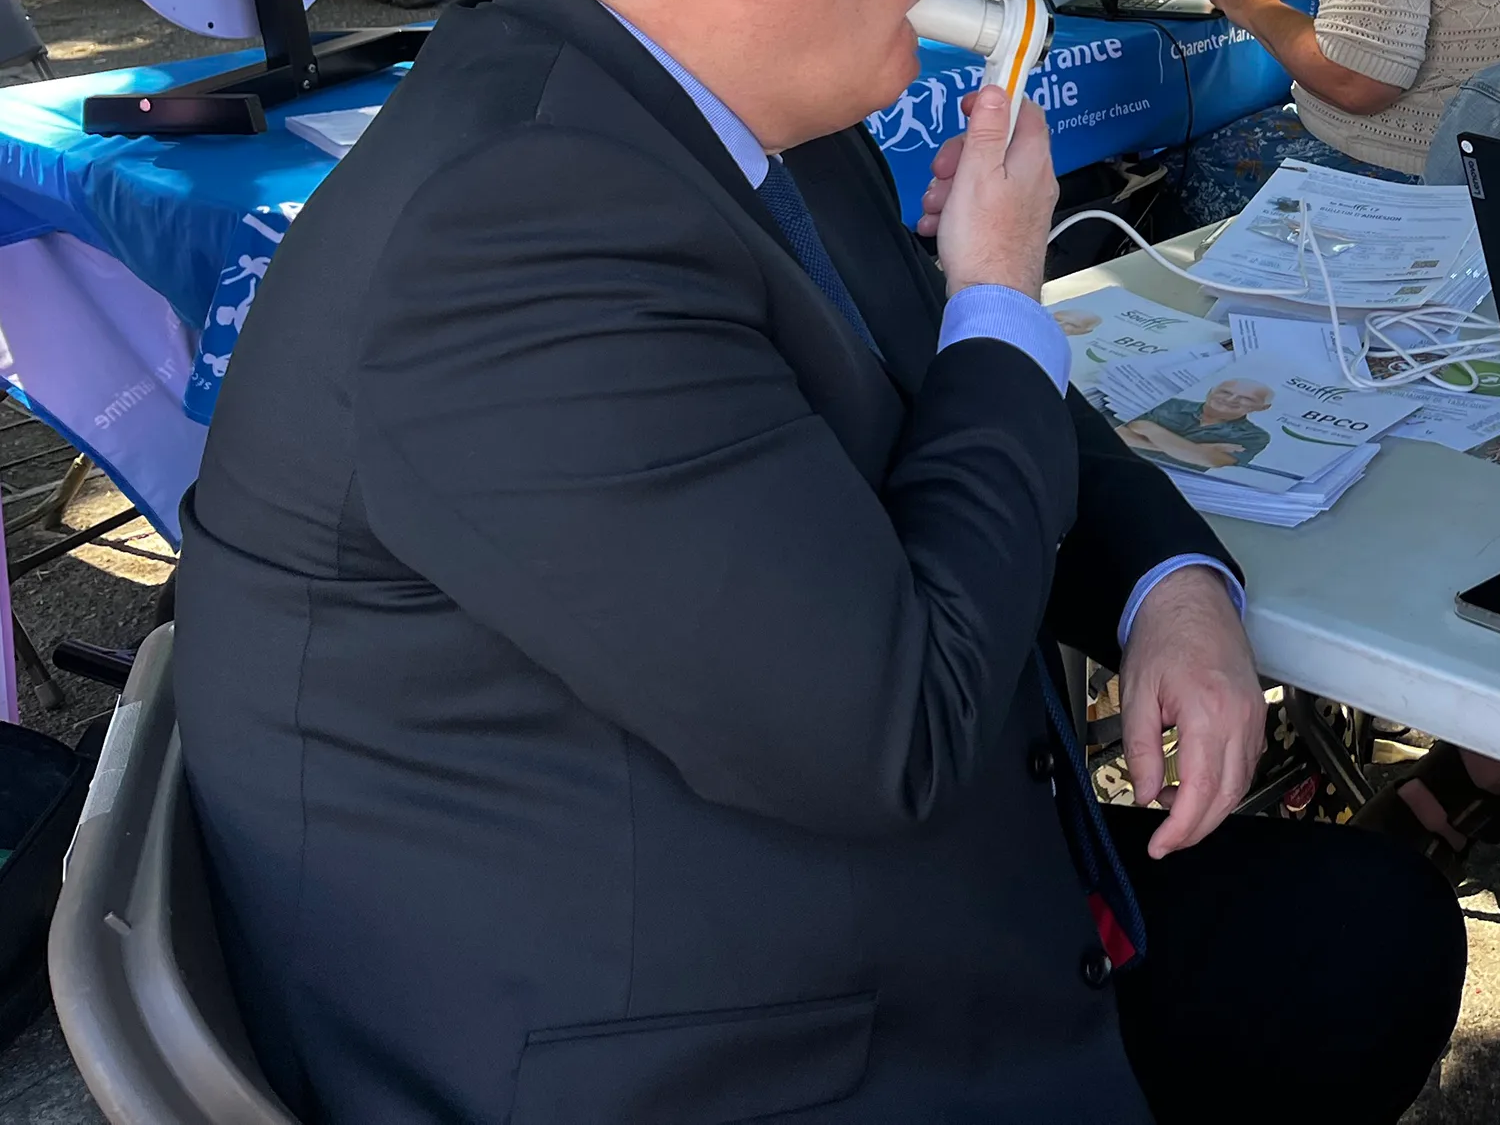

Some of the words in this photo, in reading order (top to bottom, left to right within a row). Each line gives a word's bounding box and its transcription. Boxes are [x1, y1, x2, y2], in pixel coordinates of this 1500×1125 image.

[1057, 109, 1107, 135] protéger
[1109, 97, 1151, 118] chacun
[1468, 160, 1482, 195] Lenovo
[1285, 377, 1358, 404] Souffle
[1301, 410, 1369, 432] BPCO
